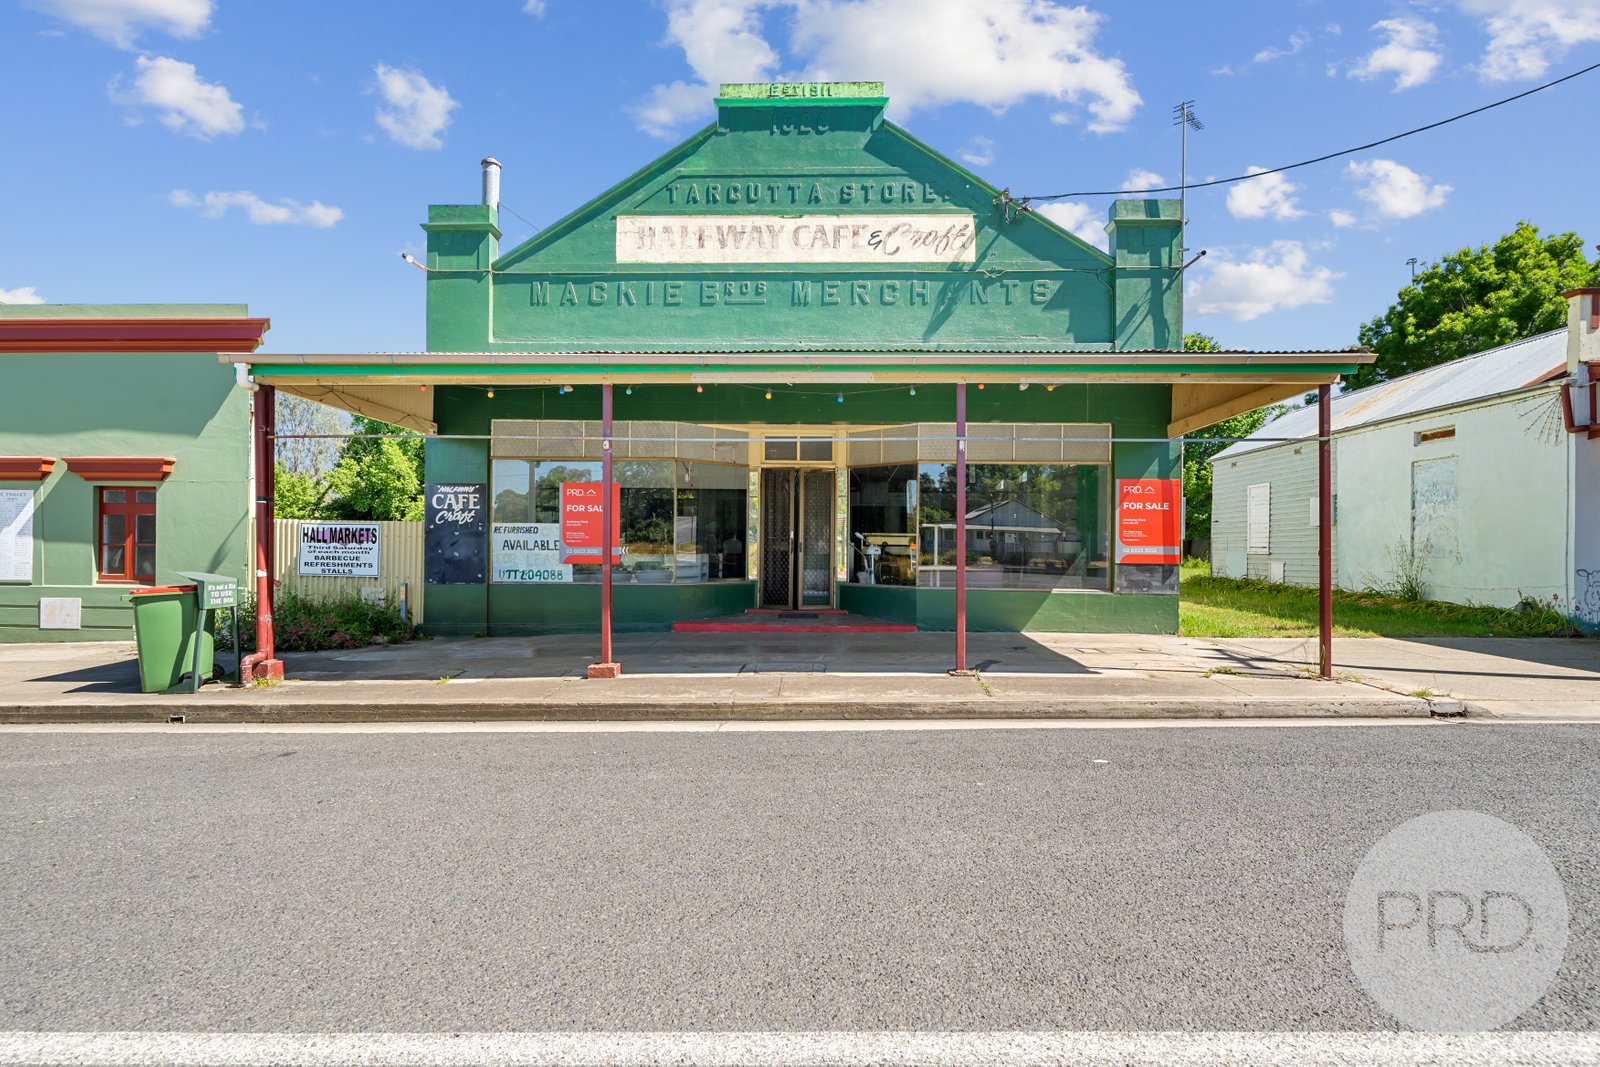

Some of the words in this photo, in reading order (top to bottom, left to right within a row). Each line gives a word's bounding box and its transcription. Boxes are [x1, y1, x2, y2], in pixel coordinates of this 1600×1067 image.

[665, 183, 823, 204] TARCUTTA
[637, 224, 785, 250] HALFWAY
[792, 224, 869, 250] CAFE
[530, 281, 683, 306] MACKIE
[432, 493, 480, 509] CAFE
[566, 504, 585, 512] FOR
[587, 504, 604, 512] SAL
[1123, 502, 1143, 510] FOR
[1145, 502, 1170, 510] SALE
[302, 526, 328, 544] HALL
[329, 527, 378, 545] MARKETS
[502, 539, 560, 551] AVAILABLE
[304, 561, 374, 569] REFRESHMENTS
